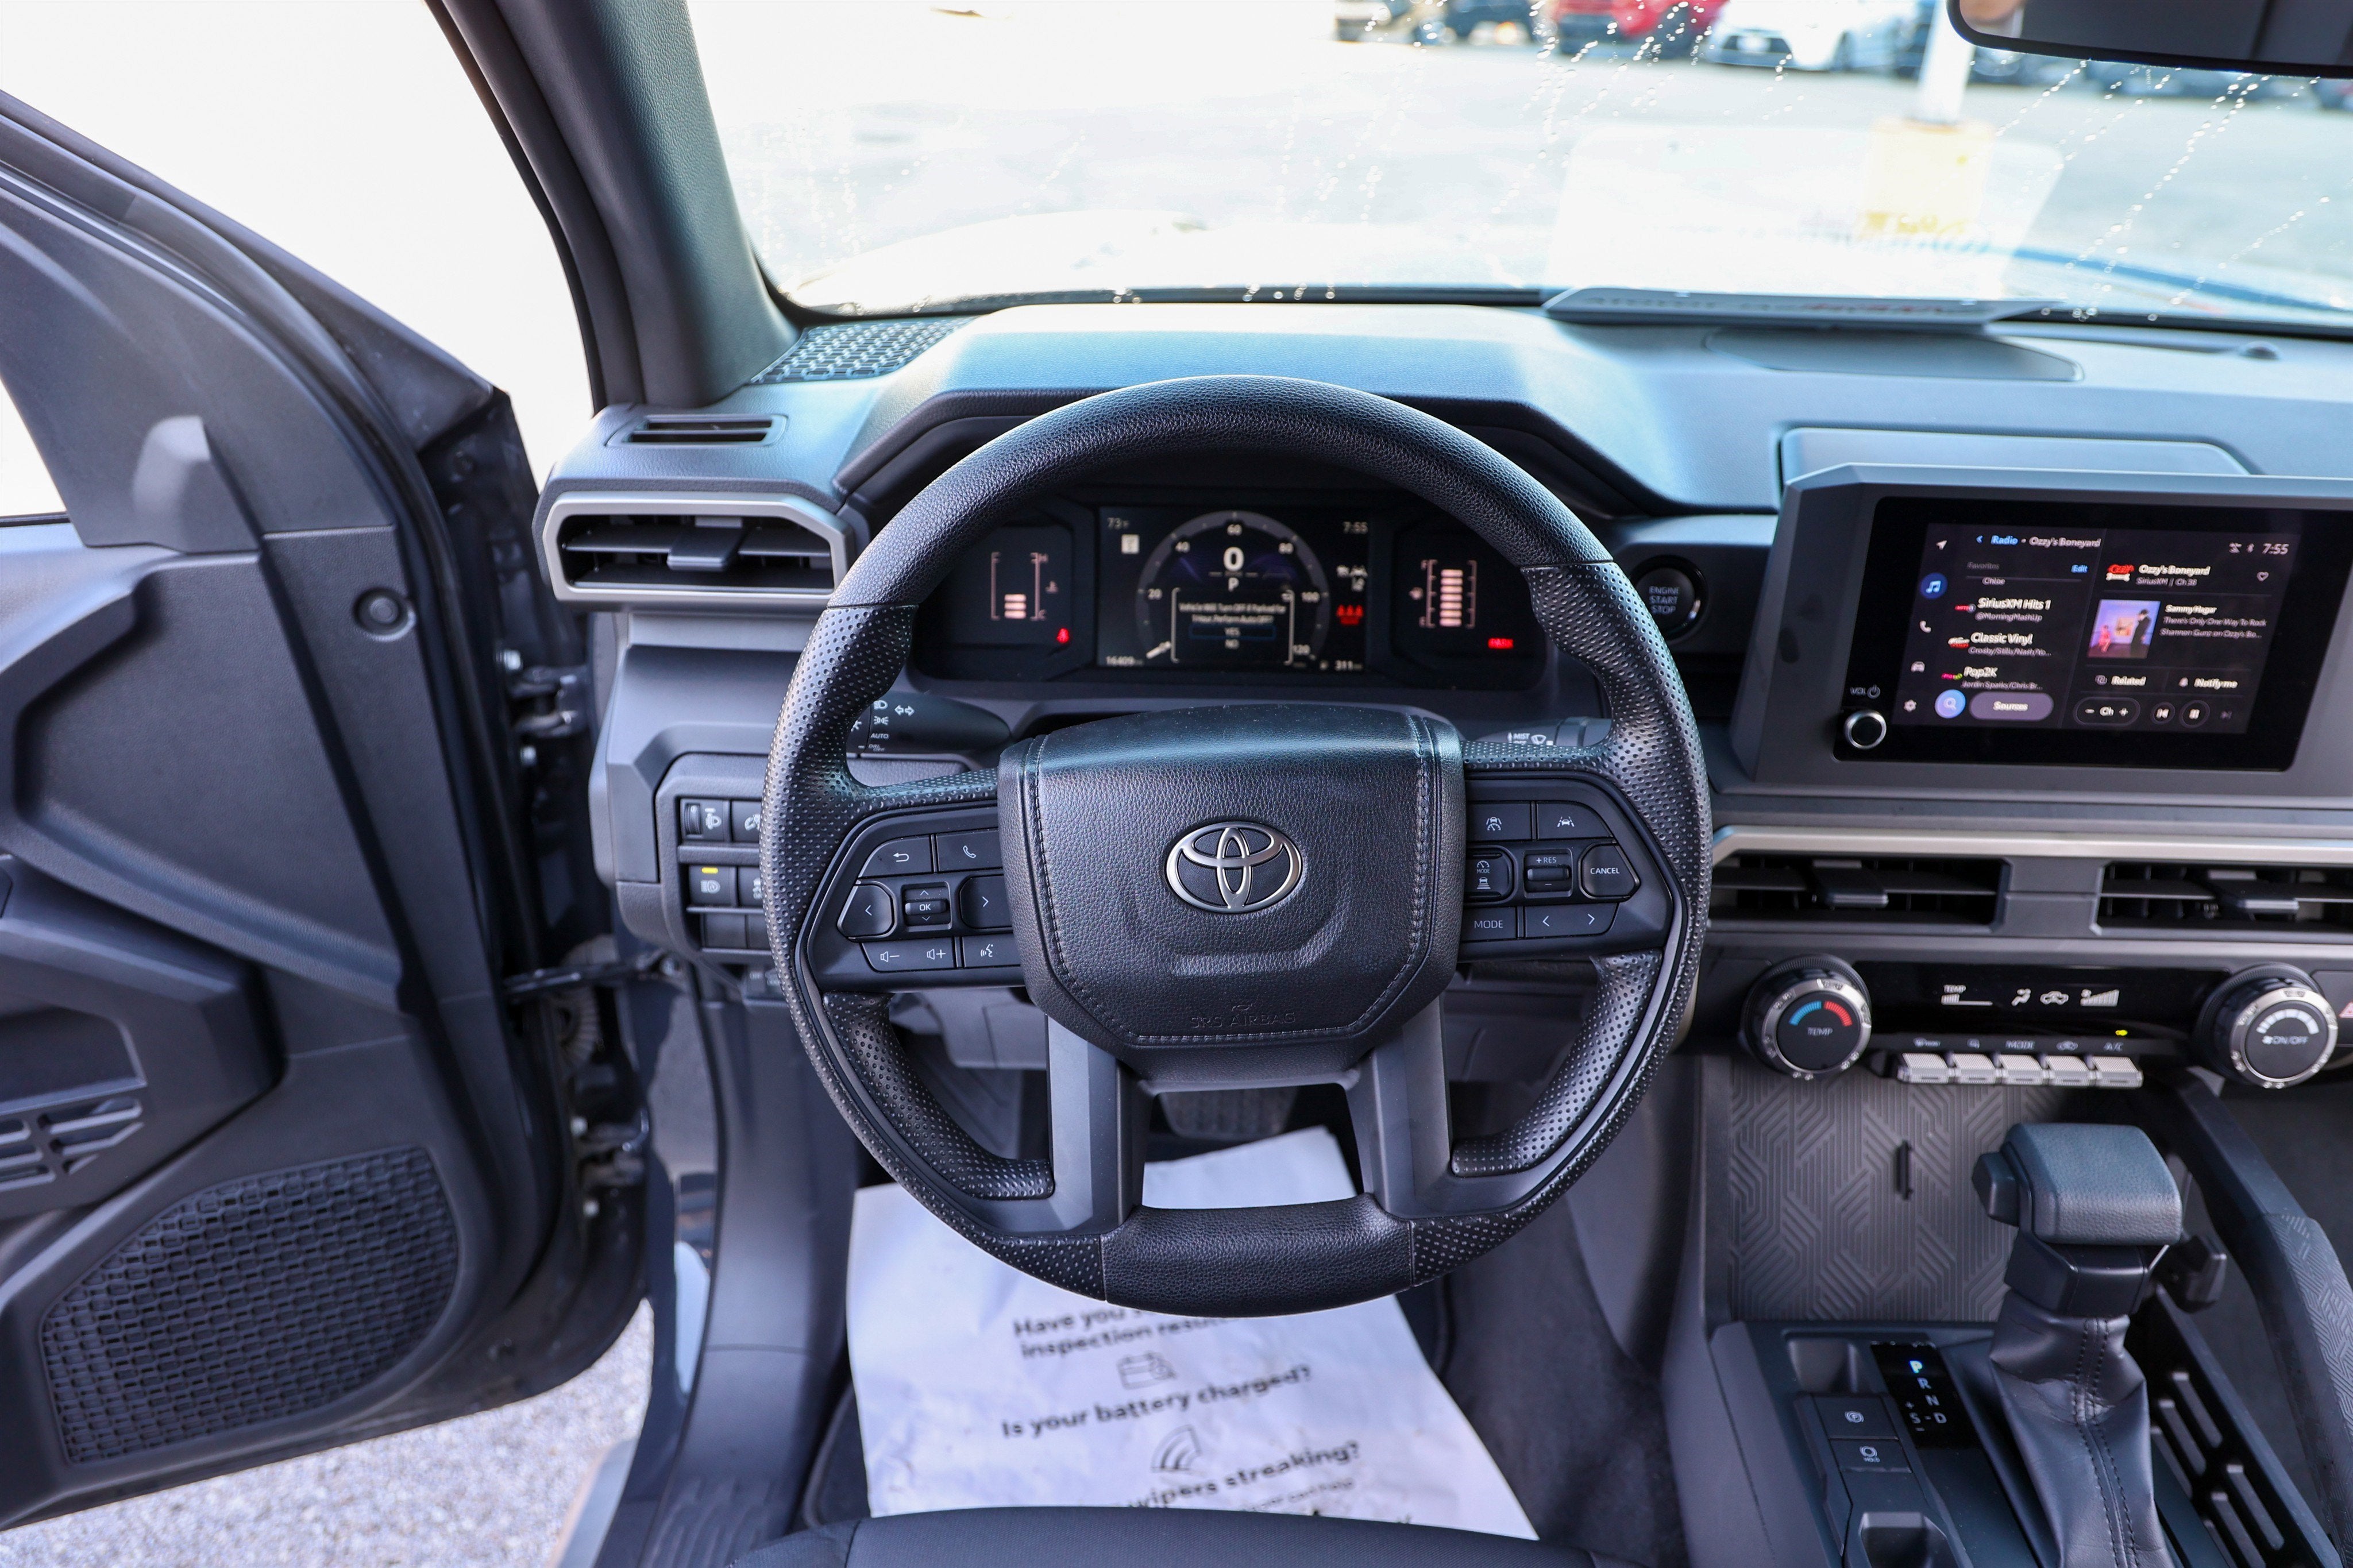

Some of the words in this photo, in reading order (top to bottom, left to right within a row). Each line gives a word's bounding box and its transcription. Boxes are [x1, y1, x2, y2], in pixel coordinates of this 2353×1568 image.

[1227, 524, 1242, 536] 60
[1991, 535, 2019, 545] Radio
[2029, 536, 2058, 549] Ozzy's
[2059, 537, 2101, 549] Boneyard
[1175, 541, 1190, 553] 40
[2262, 543, 2289, 555] 7:55
[1223, 546, 1244, 571] 0
[1967, 562, 2000, 570] Favorites
[2071, 564, 2088, 573] Edit
[2138, 563, 2168, 576] Ozzy's
[2168, 565, 2211, 577] Boneyard
[1228, 577, 1239, 592] P
[2135, 577, 2169, 586] SiriusXM
[2175, 578, 2187, 586] Ch
[1649, 586, 1680, 594] ENGINE
[1649, 595, 1678, 605] START
[1977, 597, 2023, 609] SiriusXM
[2023, 598, 2044, 610] Hits
[1650, 605, 1677, 615] STOP
[2165, 604, 2193, 615] Sammy
[2193, 605, 2217, 616] Hagar
[1975, 612, 2043, 623] @MorningMashUp
[2189, 617, 2206, 627] Only
[2223, 618, 2239, 627] Way
[1970, 632, 2007, 644] Classic
[2007, 634, 2033, 646] Vinyl
[1964, 666, 1998, 679] Pop2K
[2111, 675, 2147, 686] Related
[2193, 677, 2221, 690] Notify
[2221, 680, 2238, 689] me
[1850, 686, 1866, 696] VOL
[1993, 701, 2028, 711] Sources
[2099, 706, 2115, 717] Ch
[1473, 920, 1503, 929] MODE
[1943, 984, 1966, 994] TEMP
[1190, 1015, 1224, 1029] SRS
[1229, 1012, 1295, 1027] AIRBAG
[1807, 1026, 1833, 1037] TEMP
[2005, 1040, 2036, 1050] MODE
[2271, 1036, 2309, 1045] ON/OFF
[2103, 1041, 2123, 1052] A/C
[1013, 1313, 1073, 1337] Have
[1080, 1307, 1127, 1330] you
[1021, 1326, 1152, 1360] inspection
[1909, 1360, 1923, 1373] P
[1917, 1377, 1931, 1389] R
[1001, 1420, 1023, 1438] Is
[1030, 1409, 1089, 1438] your
[1094, 1391, 1190, 1422] battery
[1197, 1364, 1311, 1404] charged?
[1925, 1395, 1940, 1406] N
[1224, 1439, 1360, 1488] streaking?
